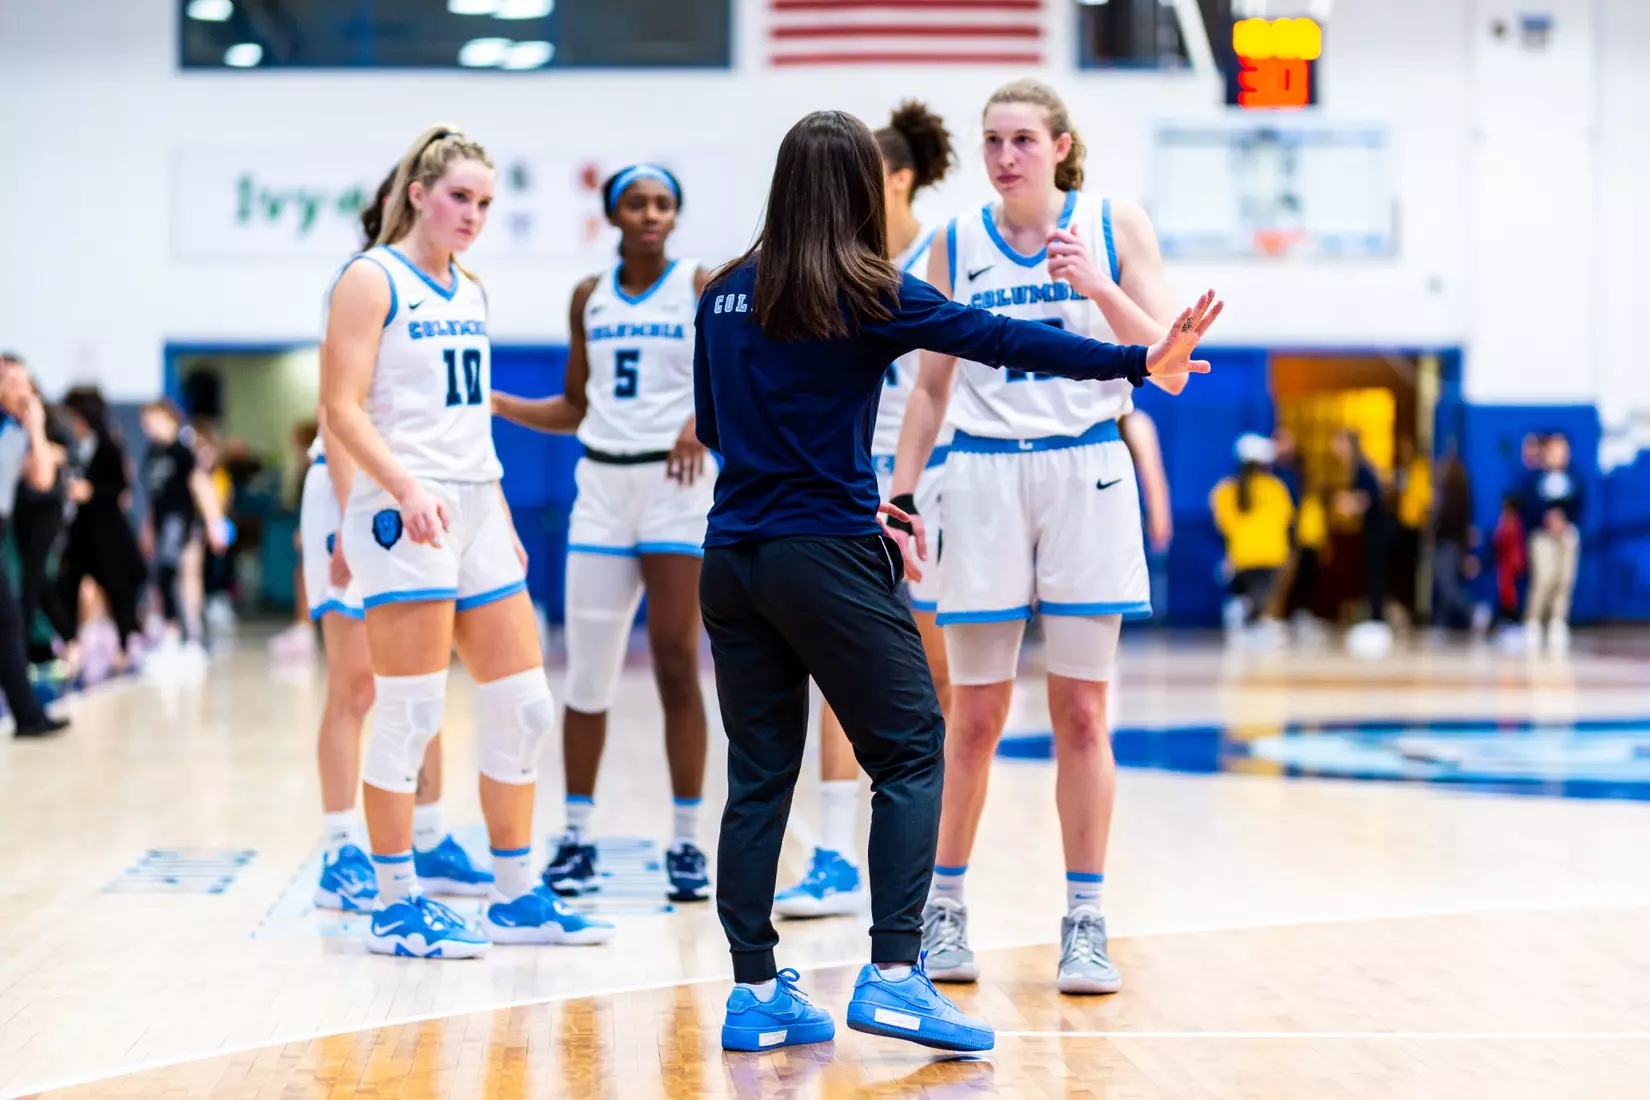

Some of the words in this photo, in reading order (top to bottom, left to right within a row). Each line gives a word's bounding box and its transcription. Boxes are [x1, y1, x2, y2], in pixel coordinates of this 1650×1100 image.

[714, 293, 753, 314] COL
[971, 281, 1089, 309] COLUMBI
[443, 348, 483, 407] 10
[614, 348, 640, 398] 5
